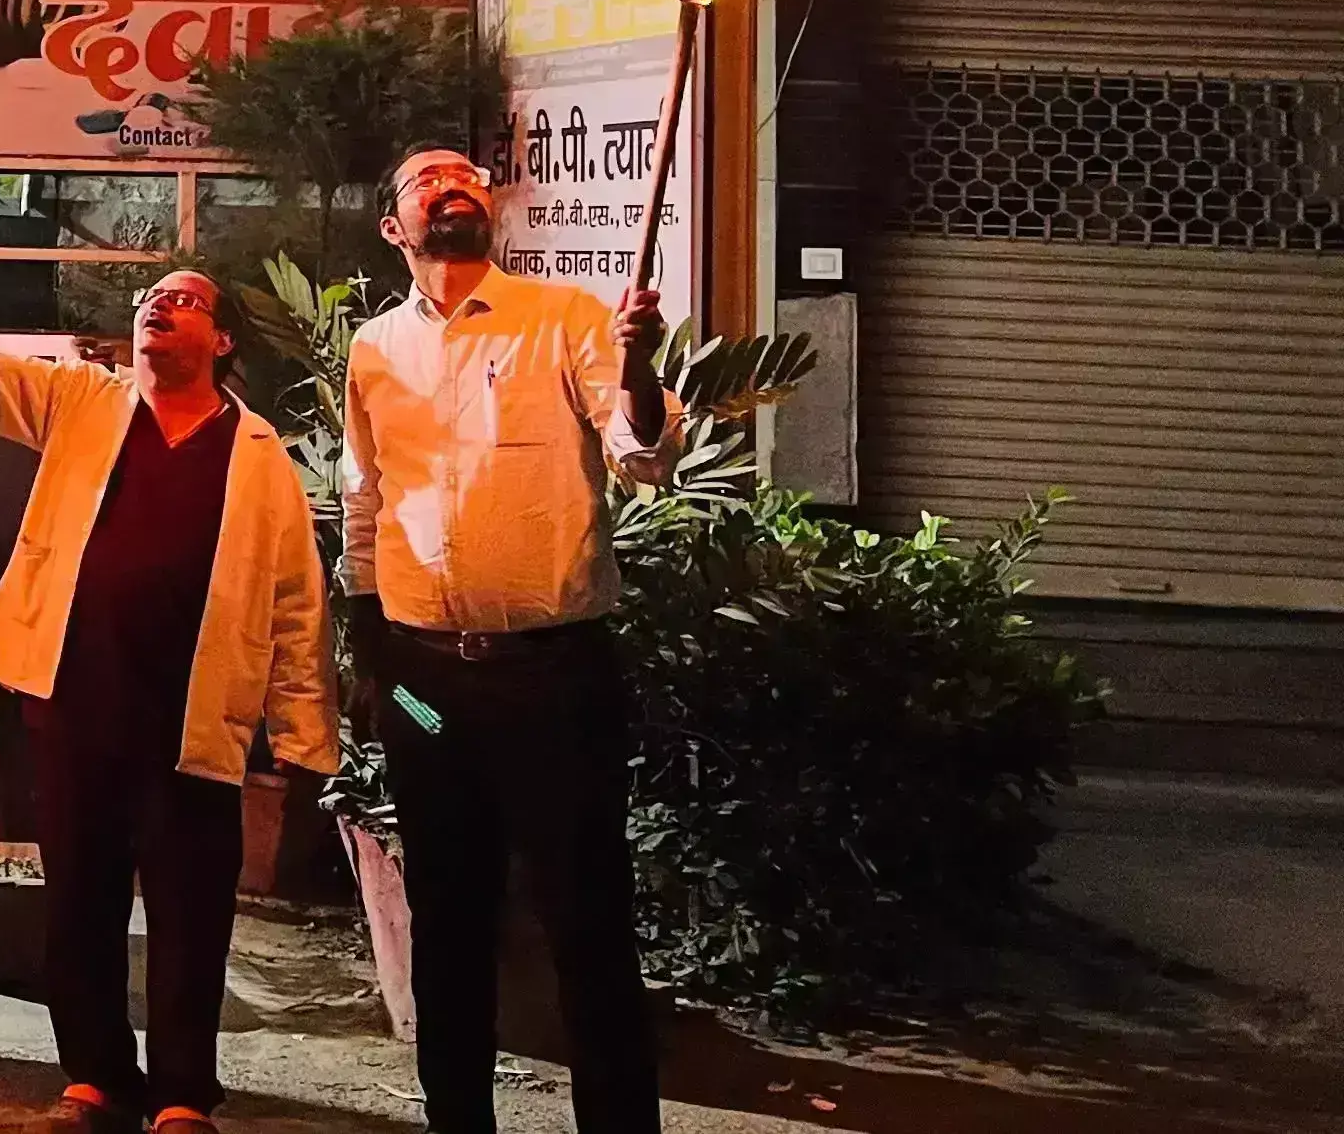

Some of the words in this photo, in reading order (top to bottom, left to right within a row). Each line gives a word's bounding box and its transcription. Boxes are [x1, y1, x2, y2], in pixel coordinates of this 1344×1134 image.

[119, 125, 192, 147] Contact
[555, 249, 594, 278] कान
[597, 249, 612, 278] व
